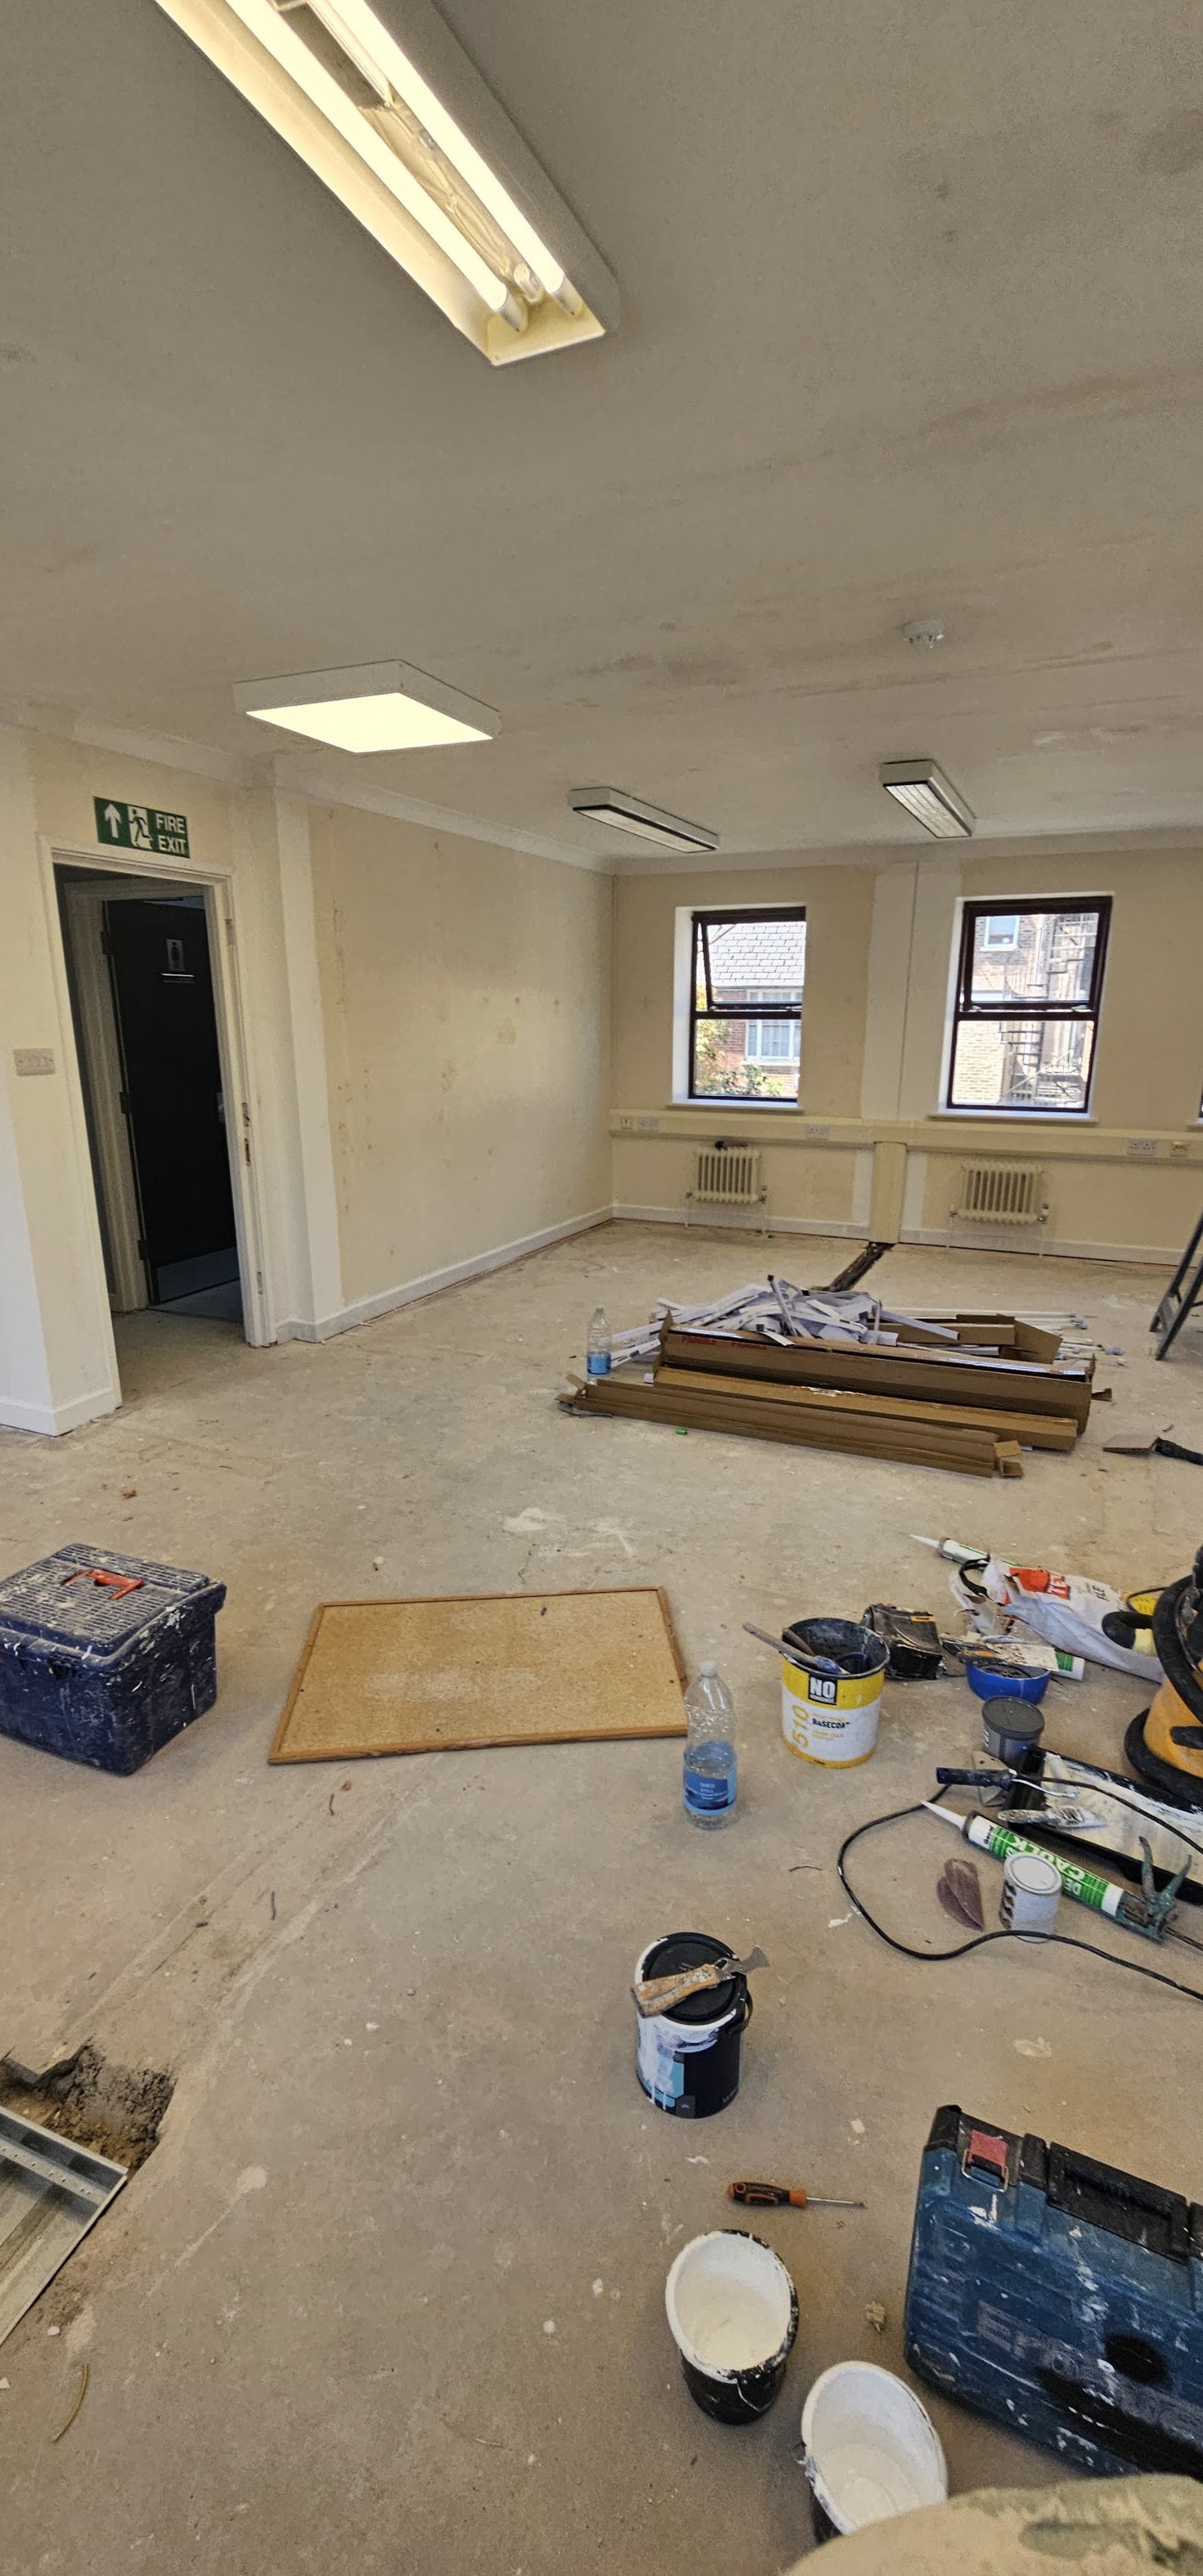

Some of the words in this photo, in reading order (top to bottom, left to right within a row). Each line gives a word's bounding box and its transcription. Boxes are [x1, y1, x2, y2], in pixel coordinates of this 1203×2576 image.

[156, 813, 186, 834] FIRE
[158, 835, 186, 854] EXIT
[810, 1677, 836, 1699] NO
[792, 1704, 809, 1748] 510
[1012, 1835, 1086, 1880] CAULK
